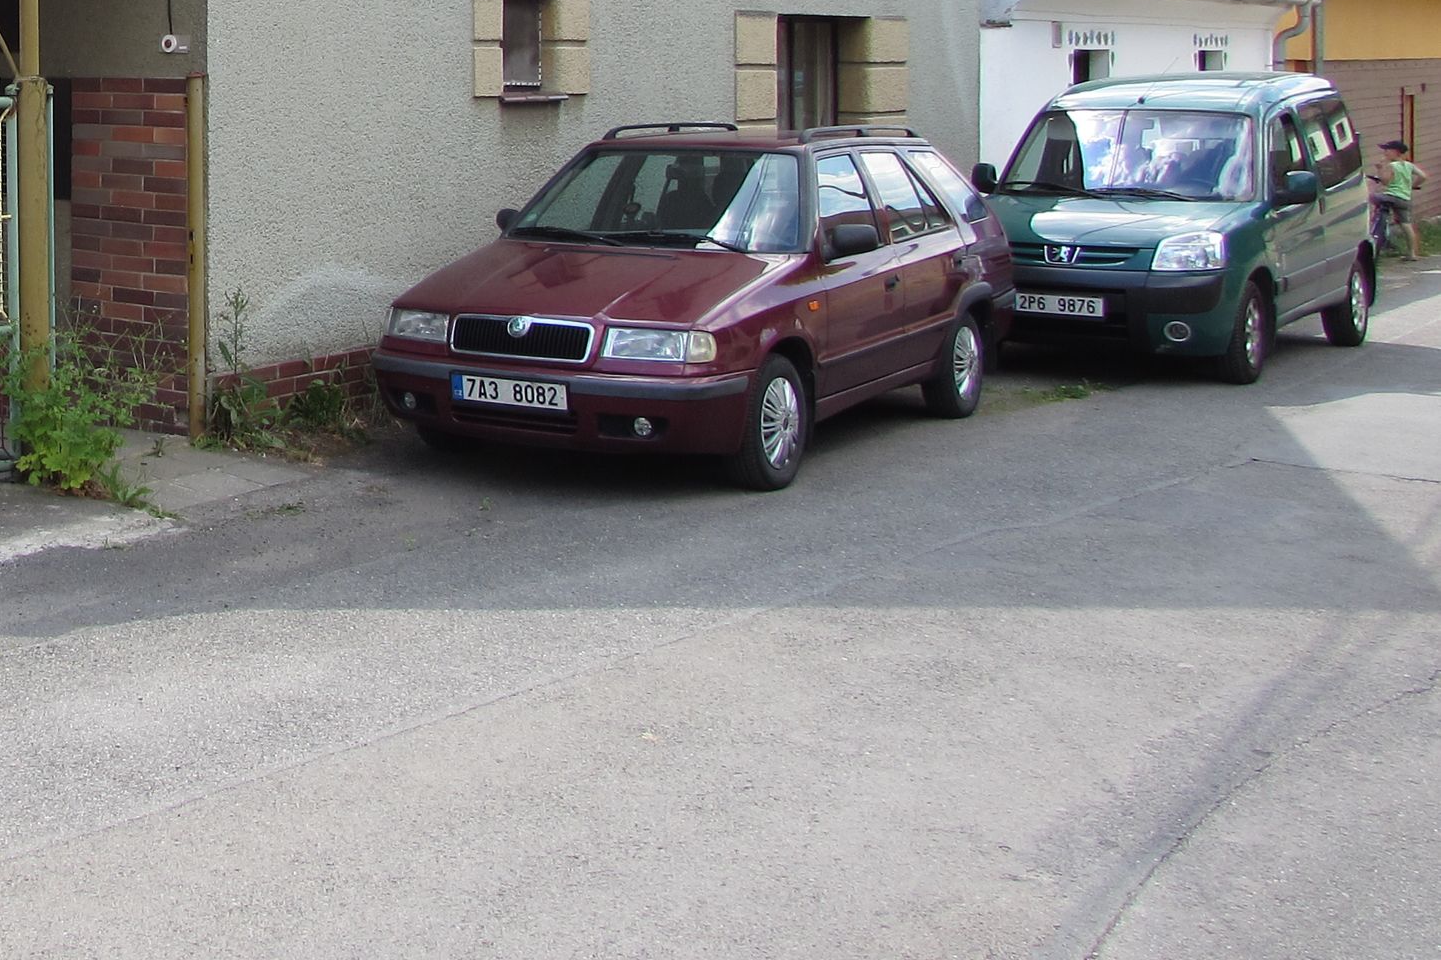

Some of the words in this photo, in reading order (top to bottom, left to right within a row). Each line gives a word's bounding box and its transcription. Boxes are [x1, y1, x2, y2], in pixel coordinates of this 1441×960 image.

[1019, 295, 1046, 311] 2P6
[1057, 297, 1096, 314] 9876
[466, 378, 499, 400] 7A3
[512, 383, 559, 406] 8082
